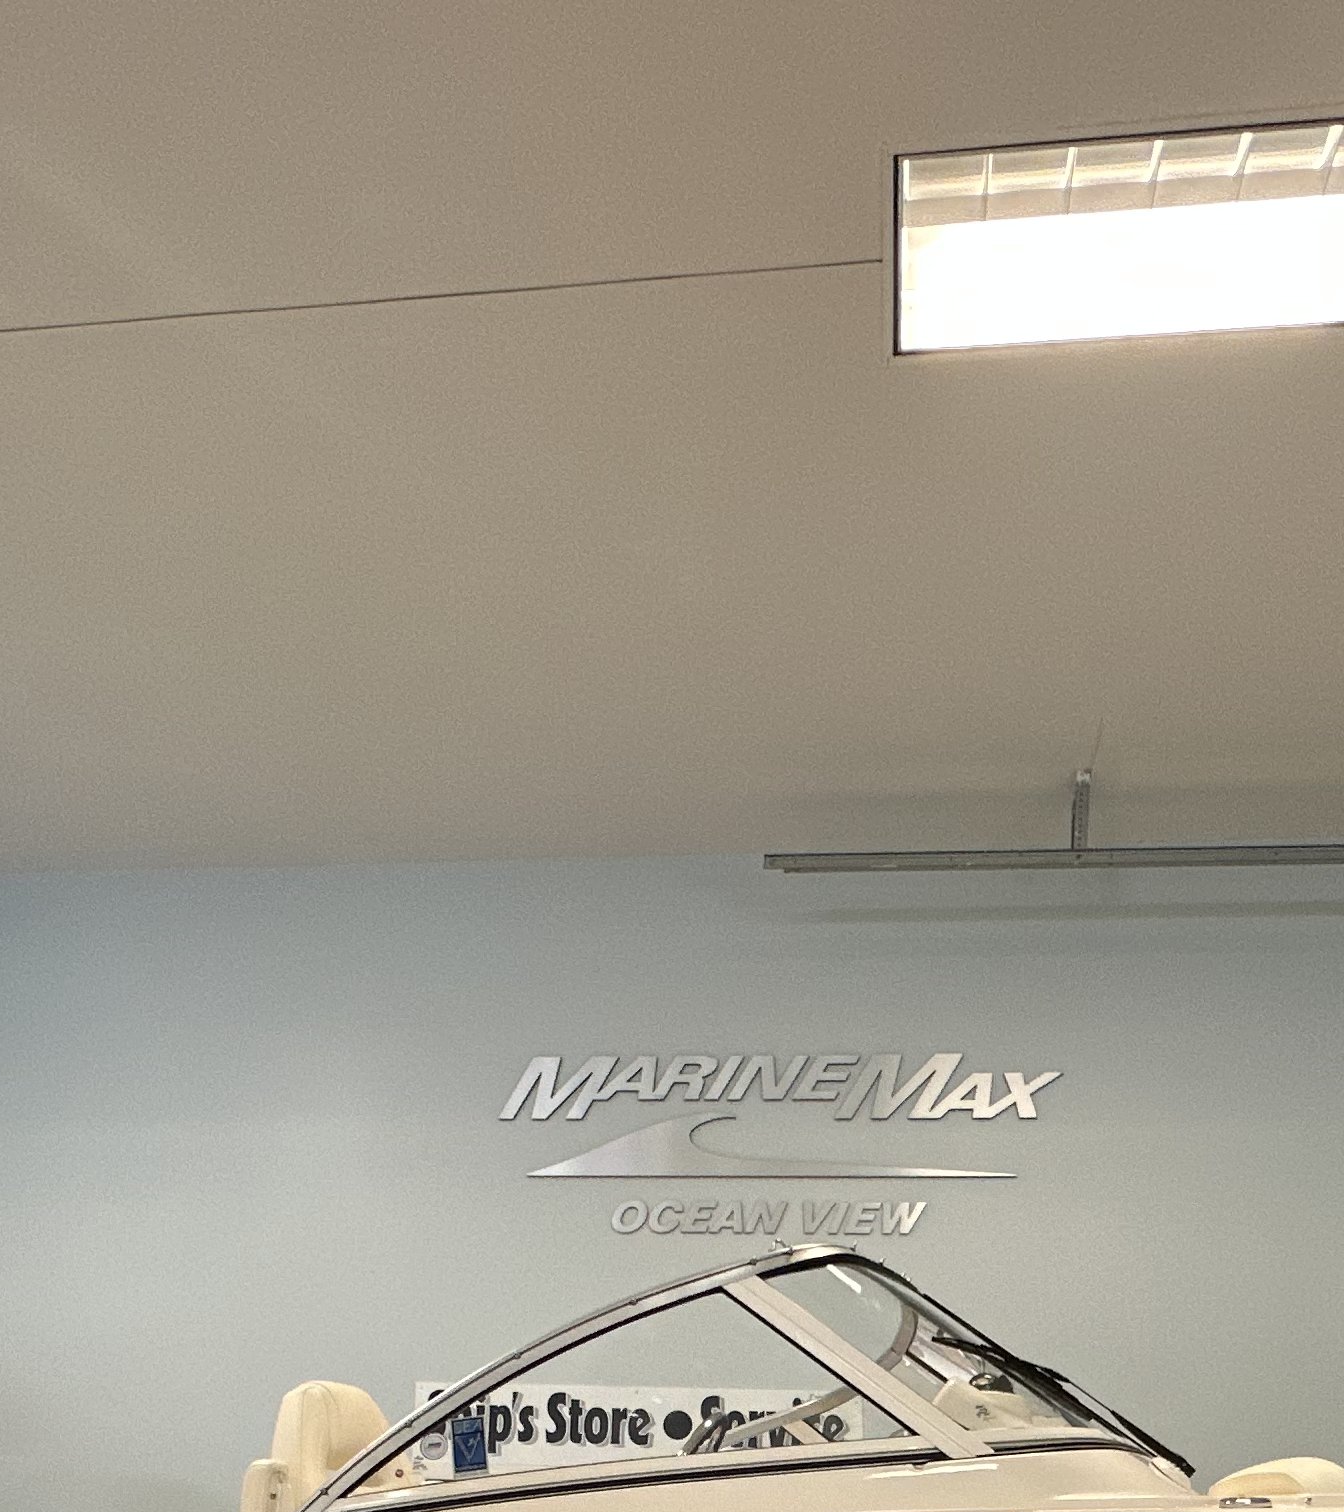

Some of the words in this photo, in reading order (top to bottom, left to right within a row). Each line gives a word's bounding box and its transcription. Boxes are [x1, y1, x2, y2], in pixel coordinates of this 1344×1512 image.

[611, 1200, 789, 1235] OCEAN
[801, 1201, 928, 1235] VIEW
[545, 1391, 654, 1446] Store
